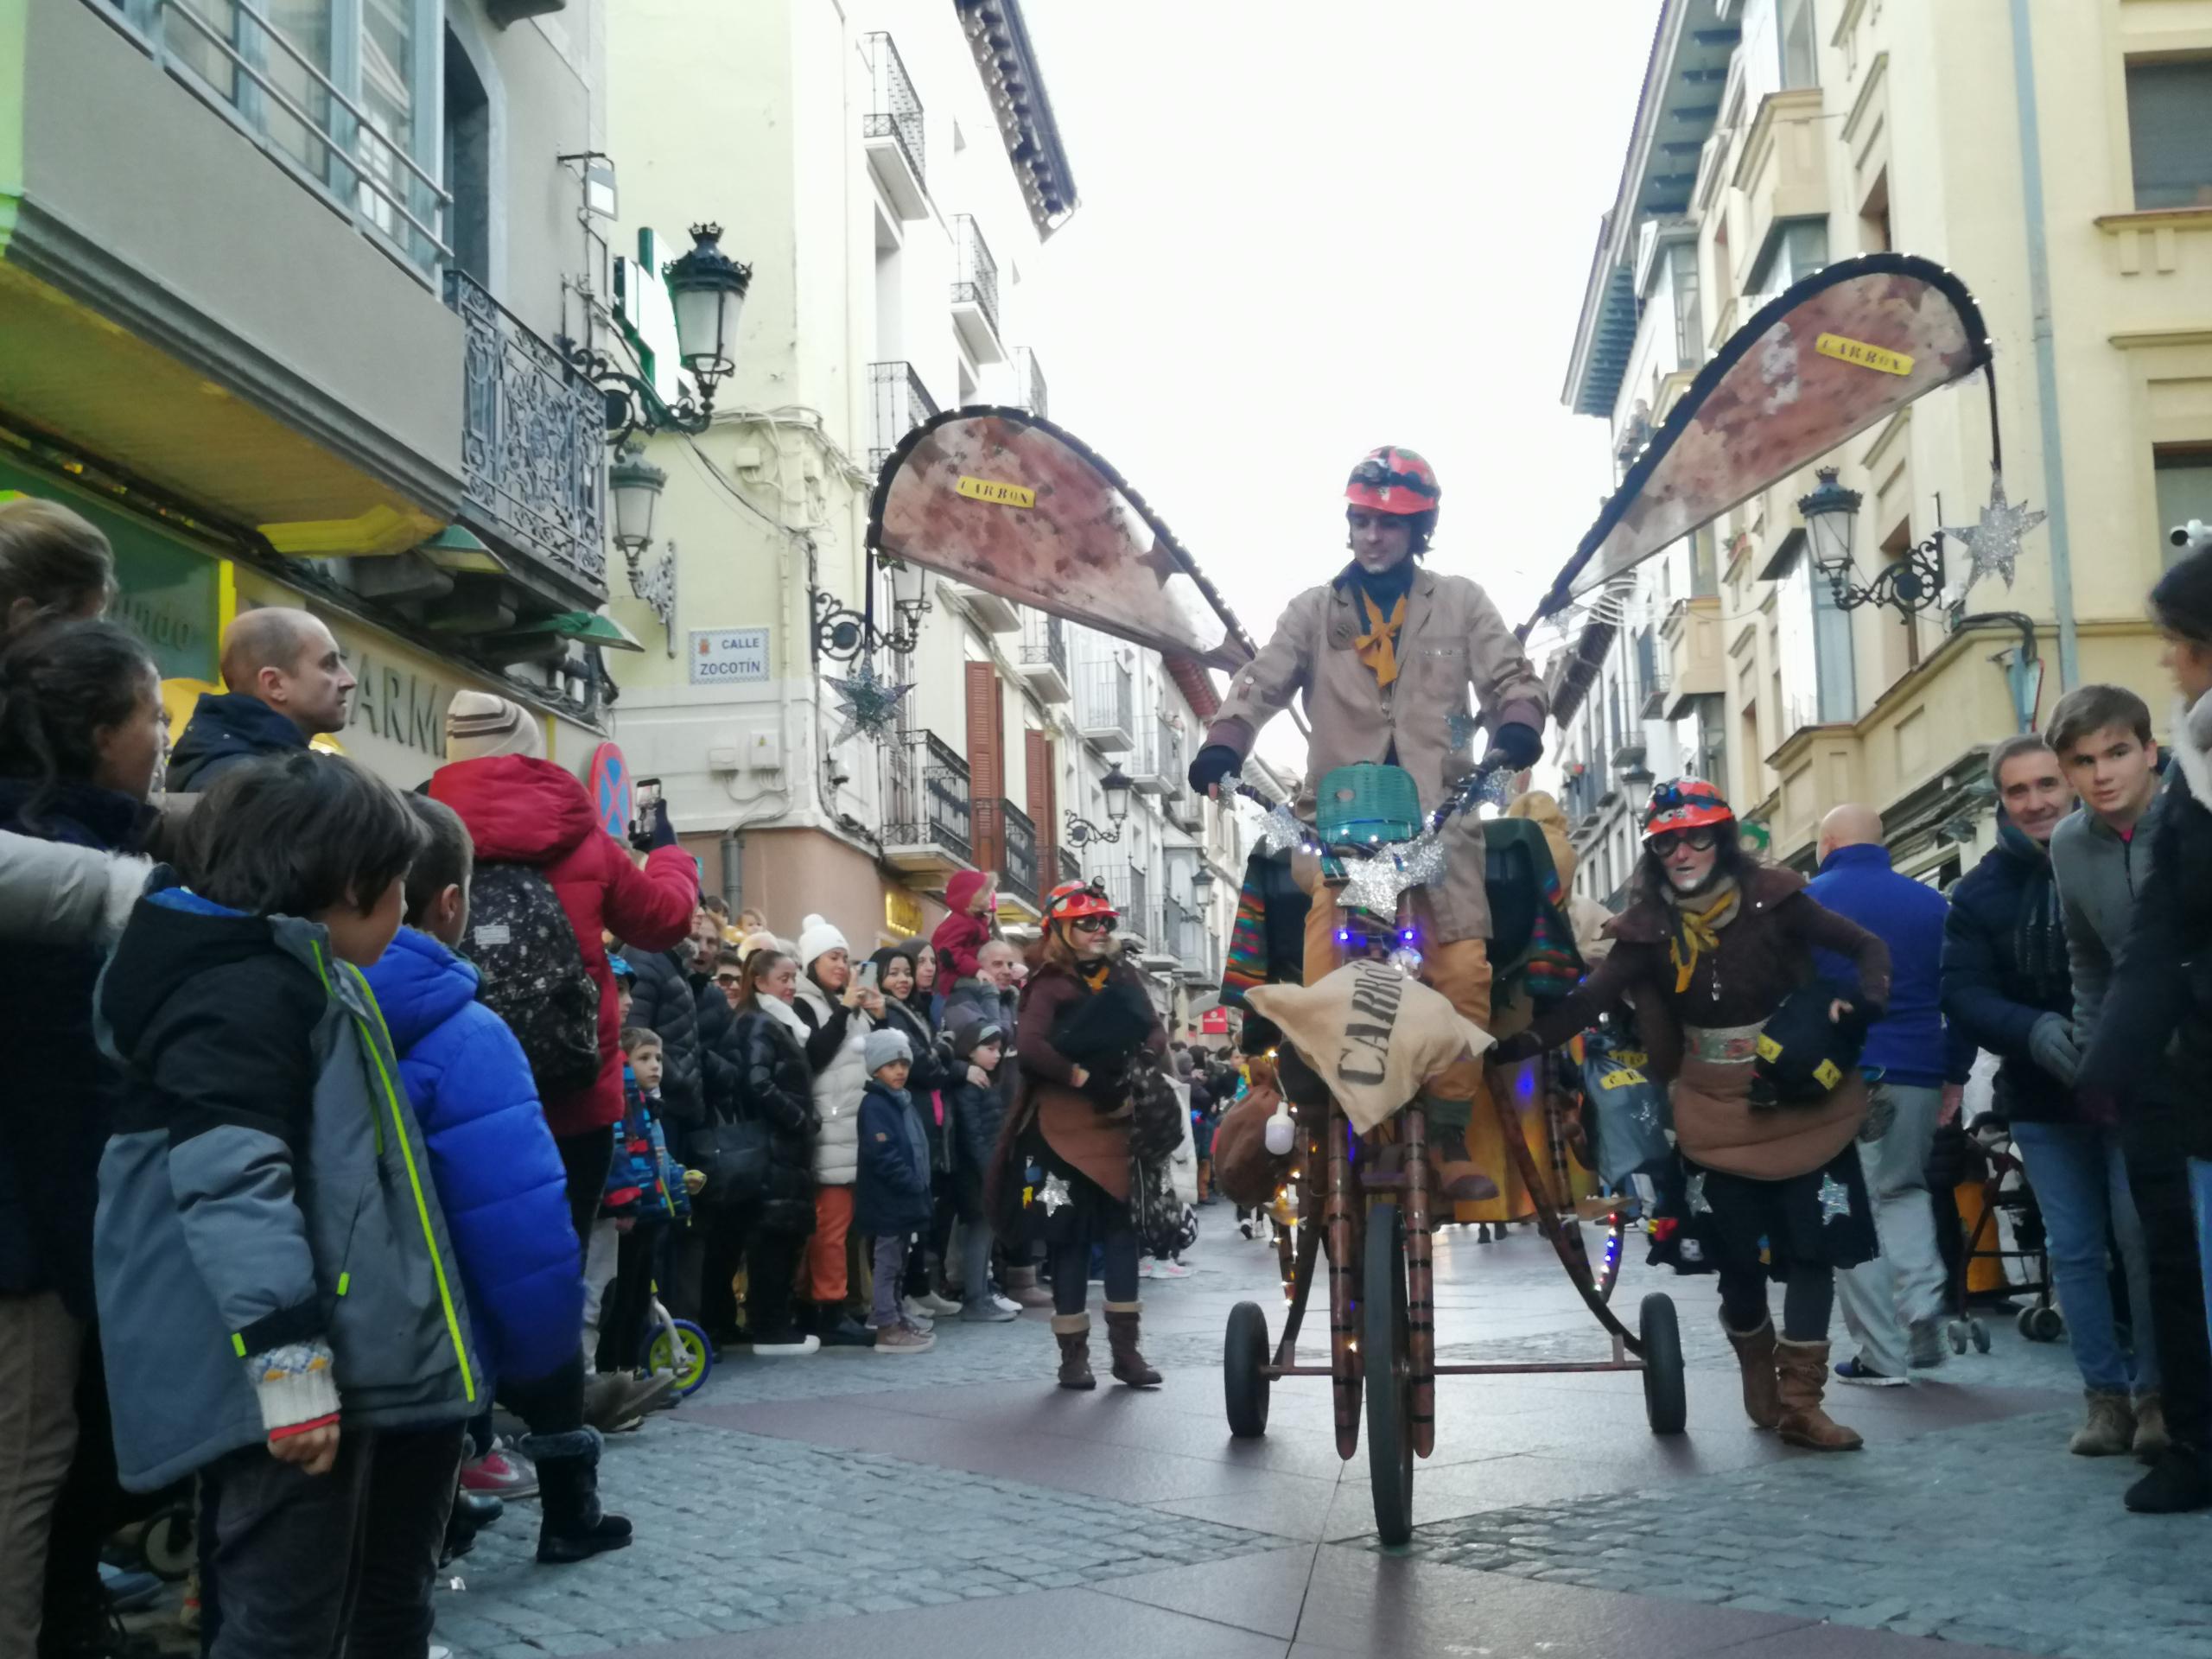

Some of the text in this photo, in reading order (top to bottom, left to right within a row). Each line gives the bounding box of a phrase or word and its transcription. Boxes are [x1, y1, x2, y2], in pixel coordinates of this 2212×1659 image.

[700, 657, 760, 676] ZOCOTÍN
[721, 638, 760, 650] CALLE
[340, 648, 447, 760] ARM
[1338, 961, 1403, 1086] CARBÓ
